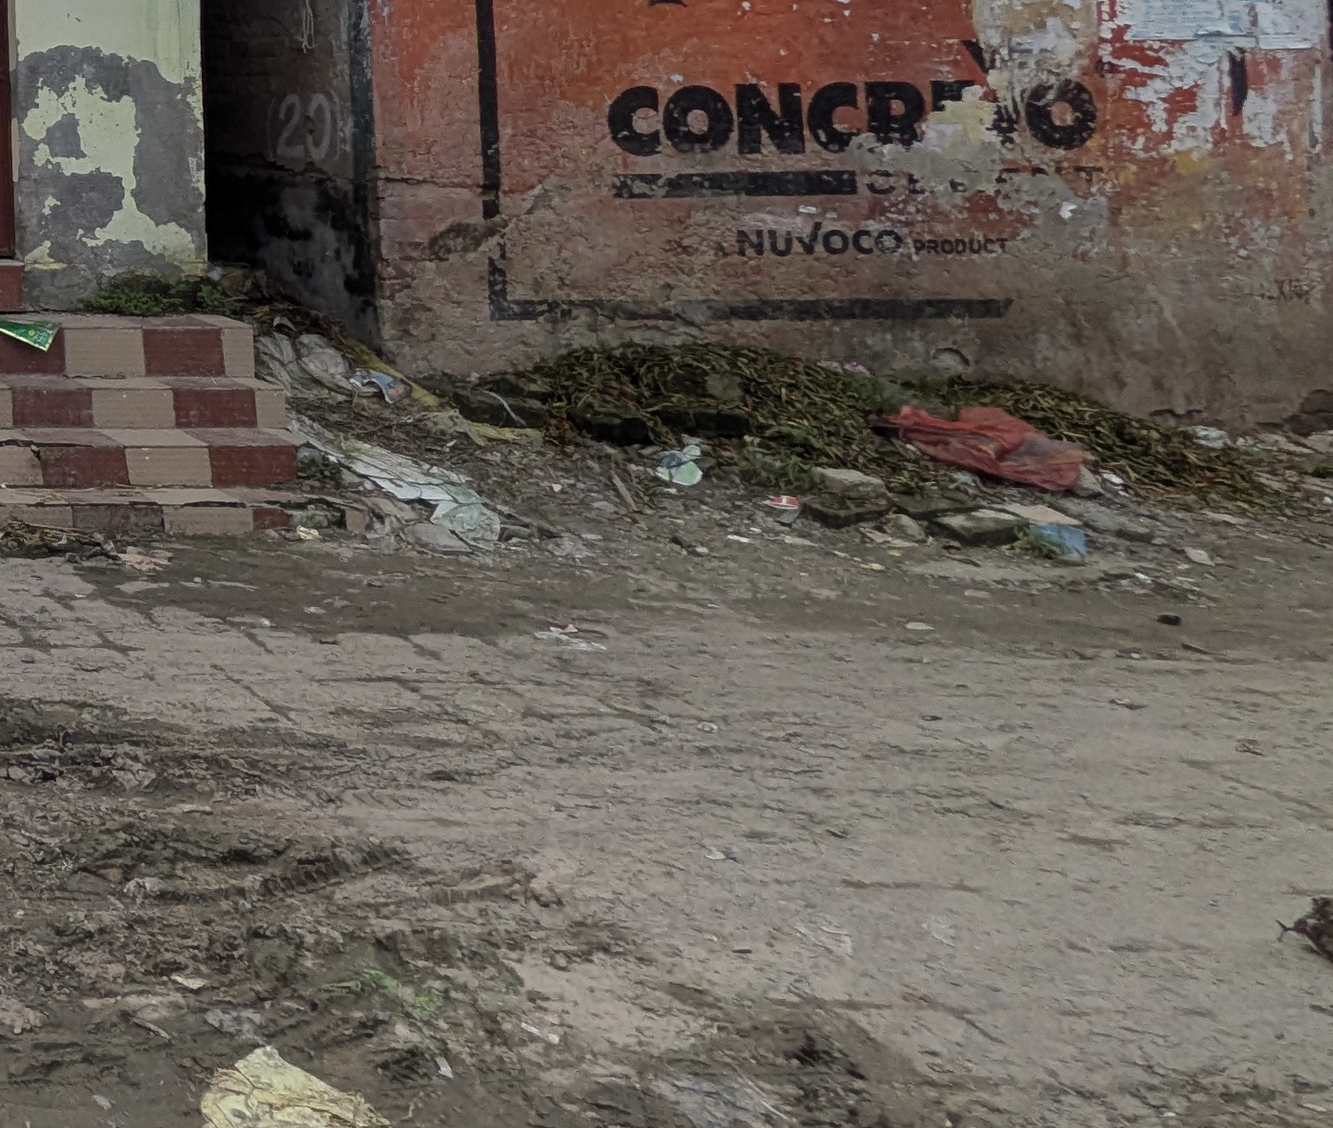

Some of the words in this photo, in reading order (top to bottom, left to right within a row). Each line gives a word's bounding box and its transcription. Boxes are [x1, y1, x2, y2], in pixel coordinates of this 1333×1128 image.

[608, 78, 1098, 157] CONCRO
[736, 222, 903, 258] NUVOCO
[913, 236, 1010, 257] PRODUCT
